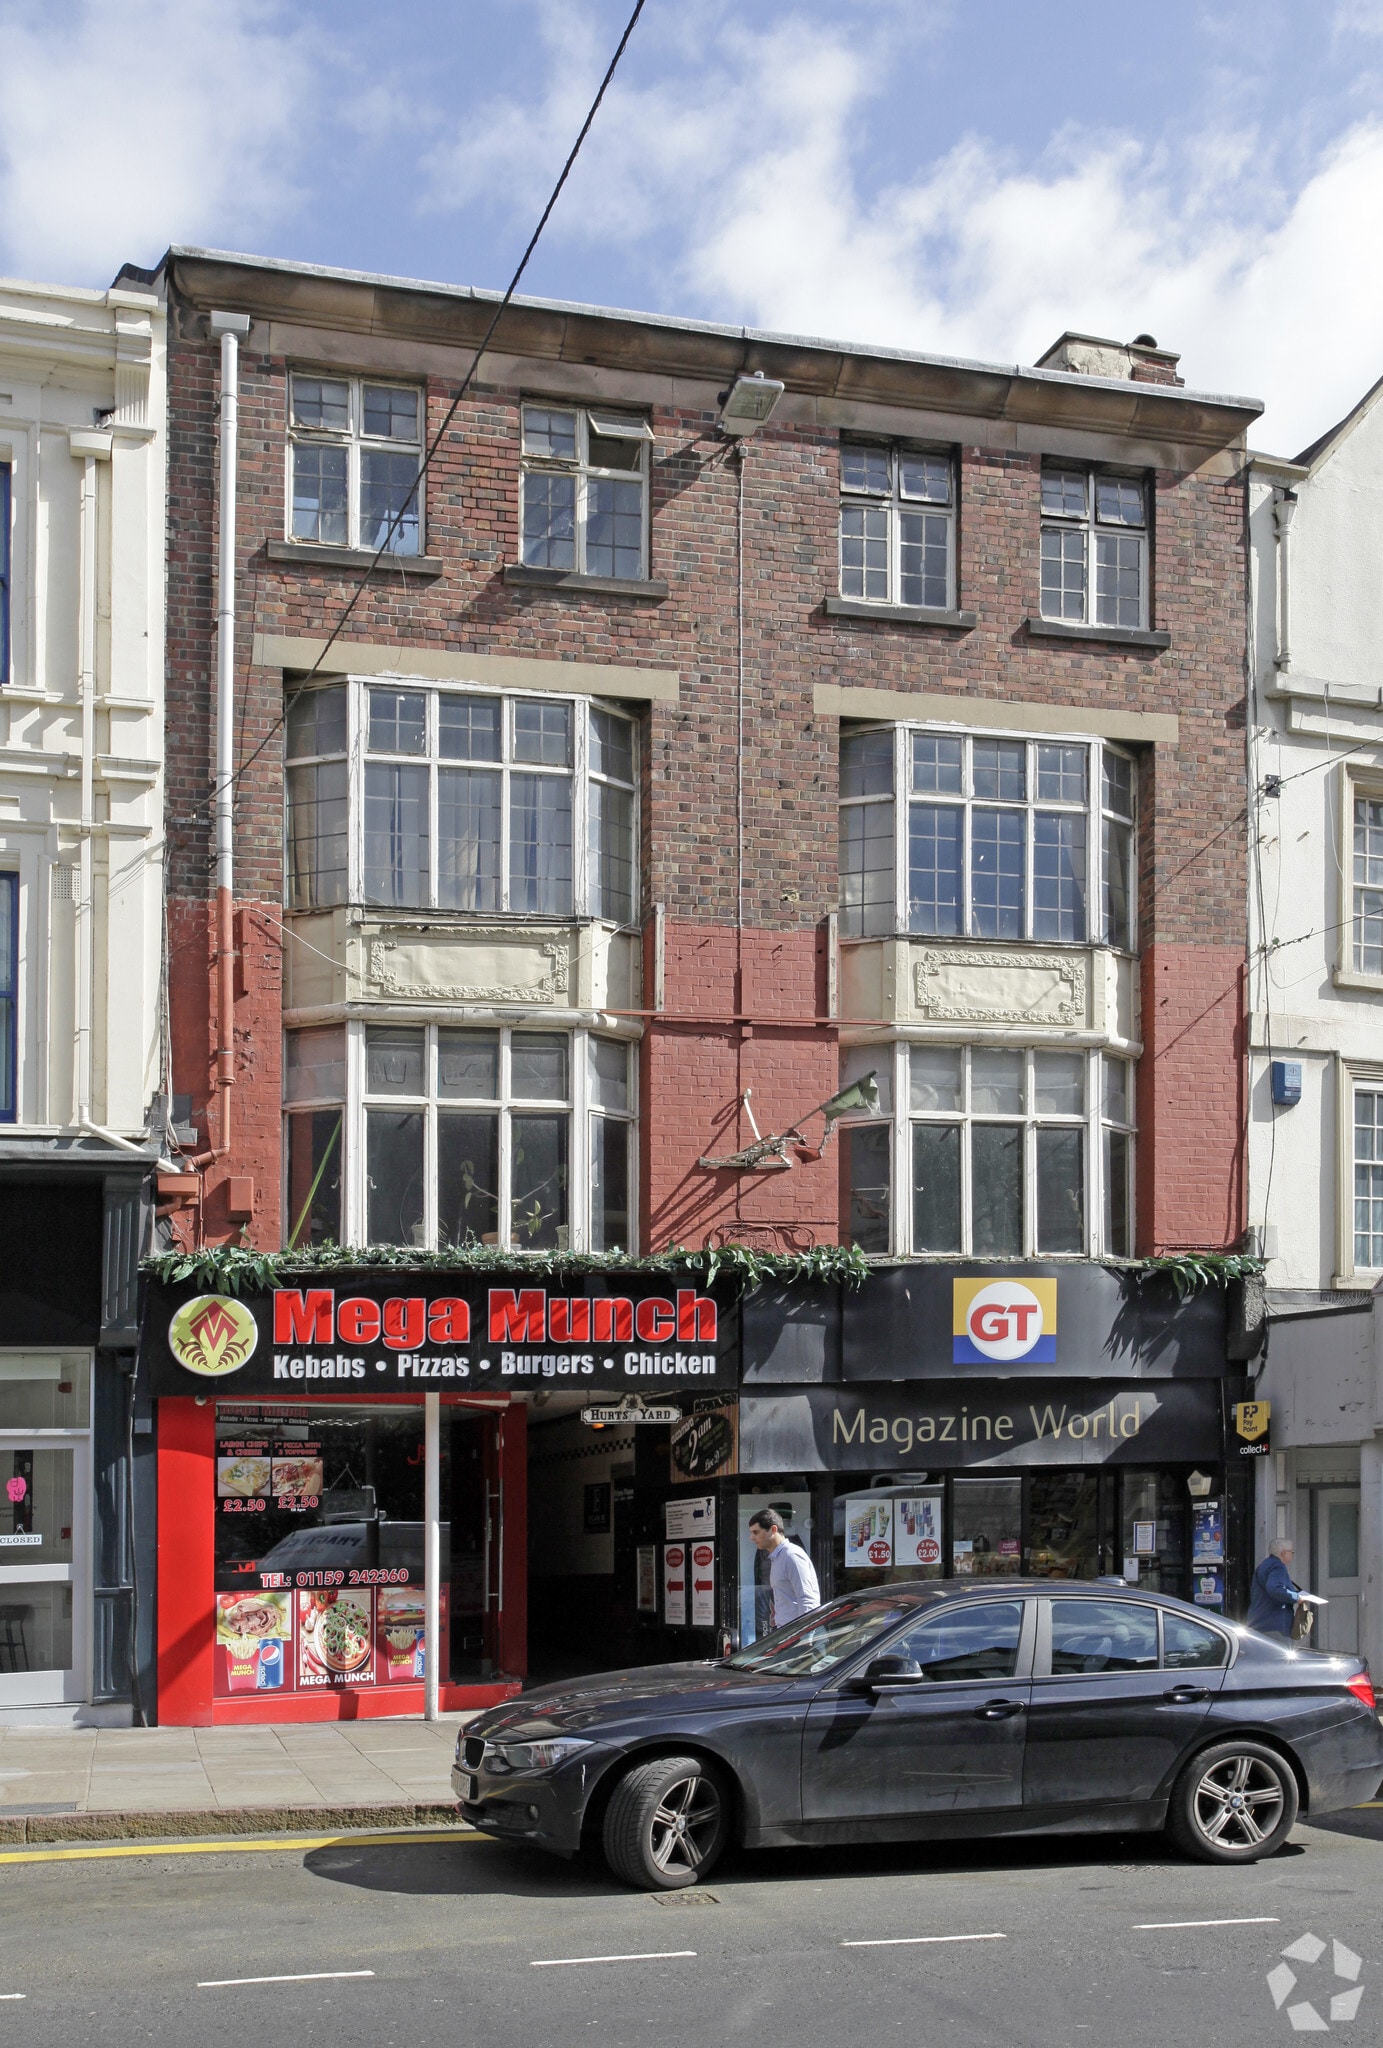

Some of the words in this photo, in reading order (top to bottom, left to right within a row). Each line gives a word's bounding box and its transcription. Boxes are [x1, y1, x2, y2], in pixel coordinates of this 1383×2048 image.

[273, 1289, 471, 1350] Mega
[487, 1288, 718, 1343] Munch
[970, 1302, 1038, 1342] GT
[273, 1354, 365, 1379] Kebabs
[398, 1353, 470, 1378] Pizzas
[501, 1352, 594, 1377] Burgers
[624, 1351, 716, 1375] Chicken
[590, 1409, 629, 1421] HURTS
[640, 1409, 671, 1420] YARD
[832, 1406, 1014, 1455] Magazine
[1028, 1400, 1141, 1439] World
[223, 1499, 266, 1512] £2.50
[278, 1496, 319, 1508] £2.50
[868, 1549, 890, 1559] £1.50
[918, 1548, 939, 1558] £2.00
[260, 1573, 292, 1588] TEL:
[296, 1570, 345, 1586] 01159
[348, 1568, 409, 1585] 242360
[230, 1668, 255, 1676] MUNCH
[300, 1676, 331, 1686] MEGA
[334, 1672, 374, 1683] MUNCH
